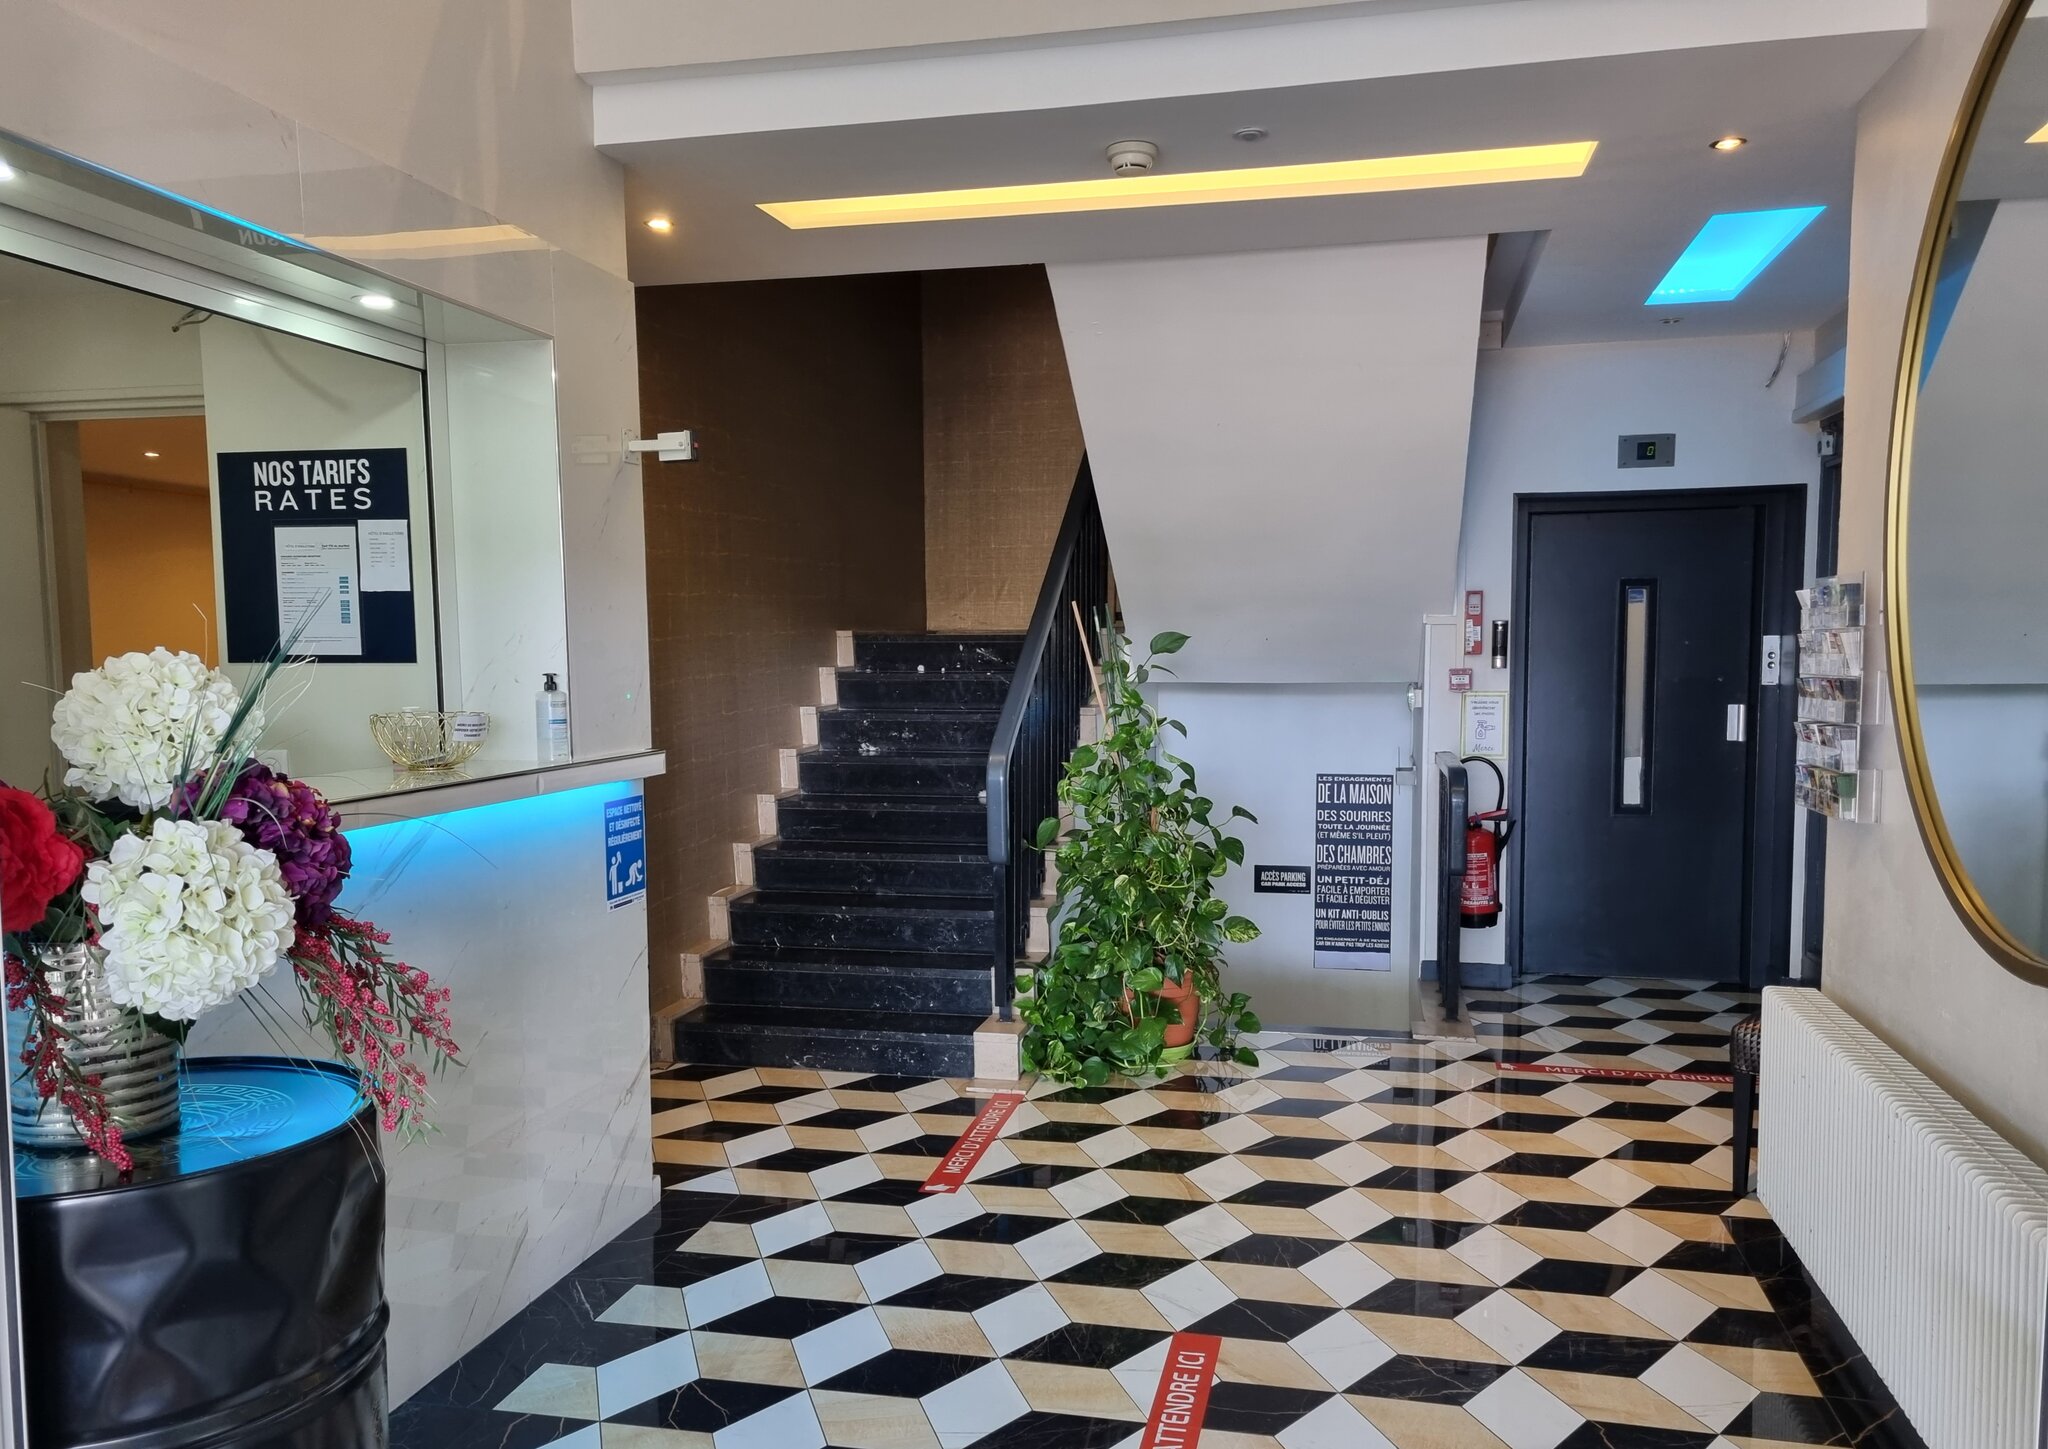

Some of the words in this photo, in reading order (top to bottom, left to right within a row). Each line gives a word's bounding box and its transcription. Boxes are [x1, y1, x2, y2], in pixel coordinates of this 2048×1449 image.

[1646, 445, 1655, 456] 0
[253, 460, 295, 487] NOS
[299, 458, 371, 485] TARIFS
[254, 487, 372, 511] RATES
[1318, 783, 1331, 803] DE
[1334, 783, 1346, 804] LA
[1349, 783, 1392, 805] MAISON
[1317, 809, 1337, 821] DES
[1339, 810, 1392, 823] SOURIRES
[1355, 823, 1391, 831] JOURNÉE
[1317, 830, 1329, 839] (ET
[1329, 829, 1351, 839] MÊME
[1352, 831, 1365, 840] S'IL
[1366, 832, 1391, 841] PLEUT)
[1316, 844, 1336, 863] DES
[1337, 844, 1392, 865] CHAMBRES
[1317, 863, 1351, 871] PRÉPARÉES
[1261, 870, 1280, 881] ACCÈS
[1280, 871, 1306, 882] PARKING
[1317, 875, 1332, 884] UN
[1334, 875, 1390, 886] PETIT-DÉJ
[1317, 884, 1342, 894] FACILE
[1342, 883, 1348, 894] À
[1349, 885, 1390, 896] EMPORTER
[1316, 894, 1325, 903] ET
[1326, 894, 1348, 904] FACILE
[1315, 908, 1327, 918] UN
[1328, 908, 1340, 919] KIT
[1341, 909, 1389, 920] ANTI-OUBLIS
[1315, 919, 1328, 930] POUR
[1346, 920, 1355, 931] LES
[1544, 1066, 1606, 1076] MERCI
[1612, 1070, 1734, 1082] D'ATTENDRE
[943, 1149, 976, 1174] MERCI
[961, 1108, 1006, 1149] D'ATTENDRE
[1176, 1351, 1206, 1370] ICI
